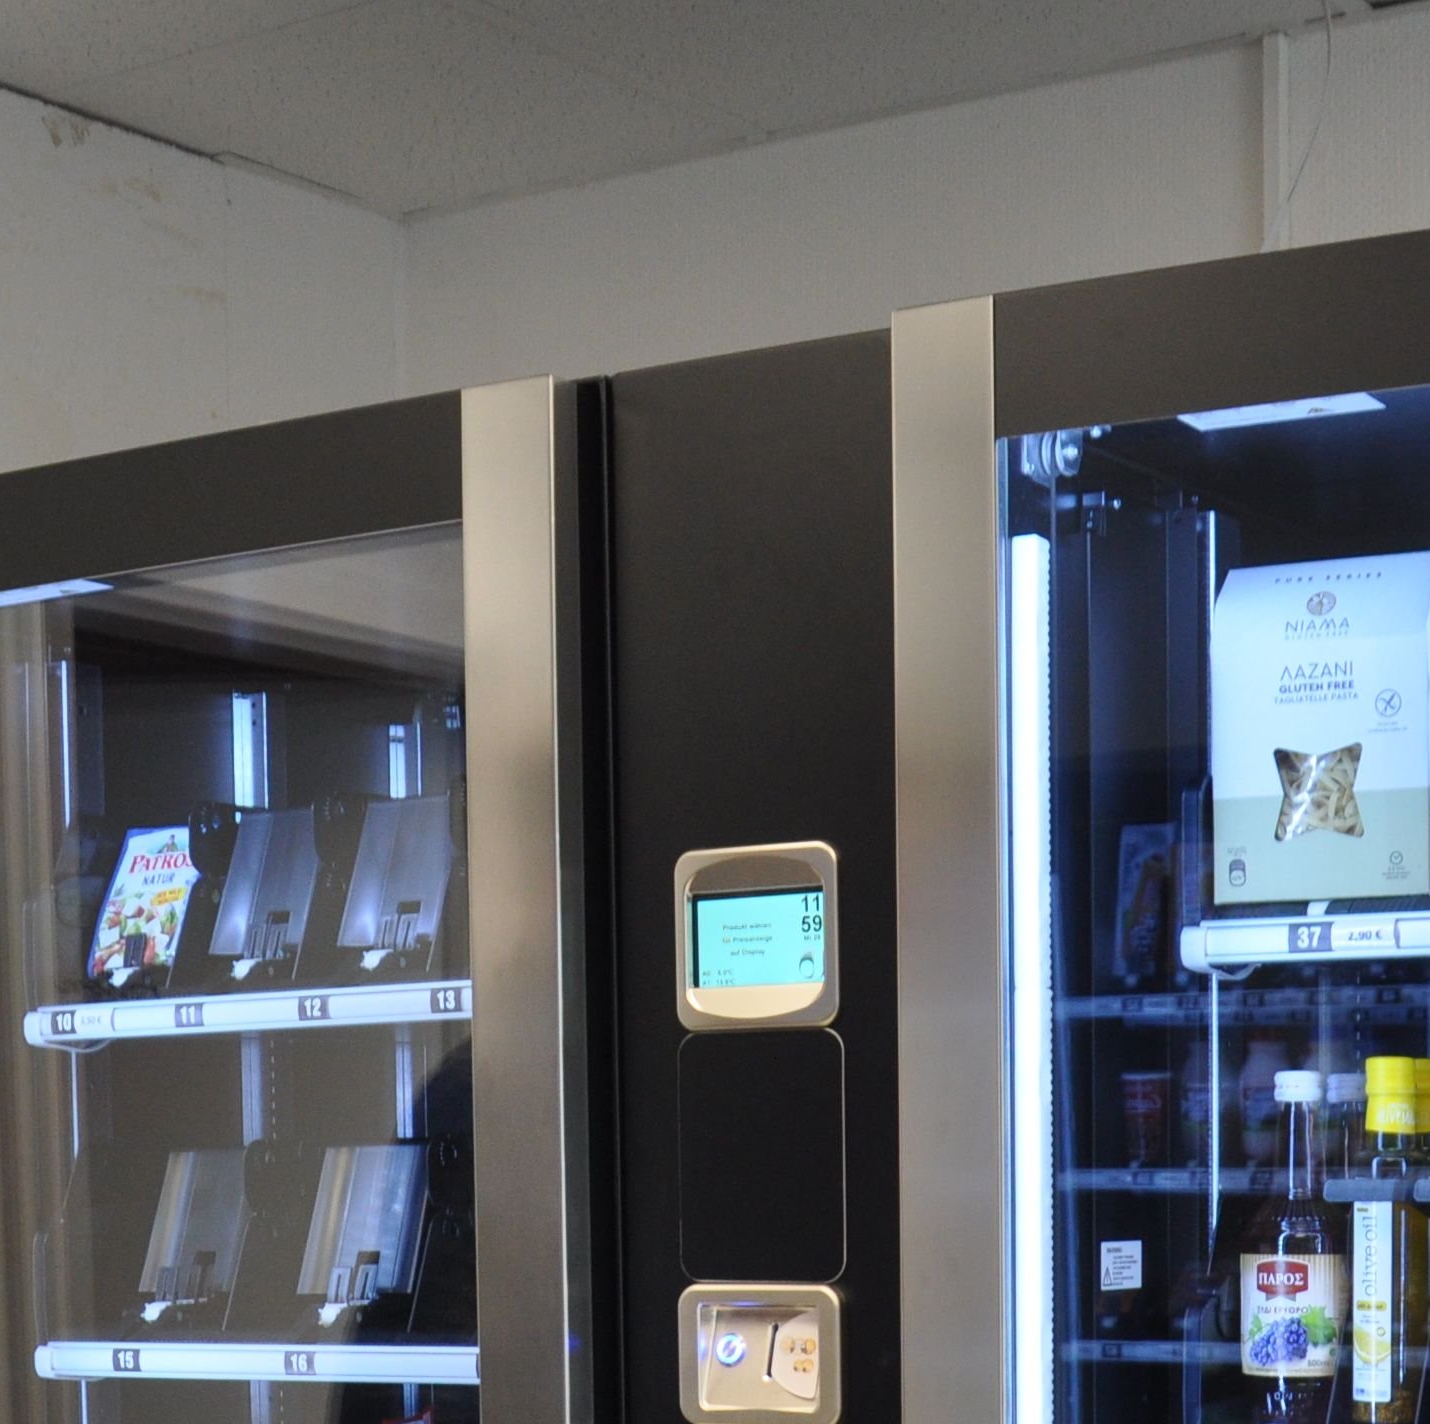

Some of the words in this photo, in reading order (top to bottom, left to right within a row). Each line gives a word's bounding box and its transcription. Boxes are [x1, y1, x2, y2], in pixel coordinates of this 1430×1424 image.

[1285, 617, 1350, 633] NIAMA
[1279, 682, 1324, 694] GLUTEN
[1327, 680, 1354, 691] FREE
[801, 894, 820, 913] 11
[801, 914, 823, 933] 59
[1296, 924, 1323, 949] 37
[437, 990, 456, 1010] 13
[1258, 1272, 1304, 1286] ΠΑΡΟΣ
[117, 1351, 134, 1369] 15
